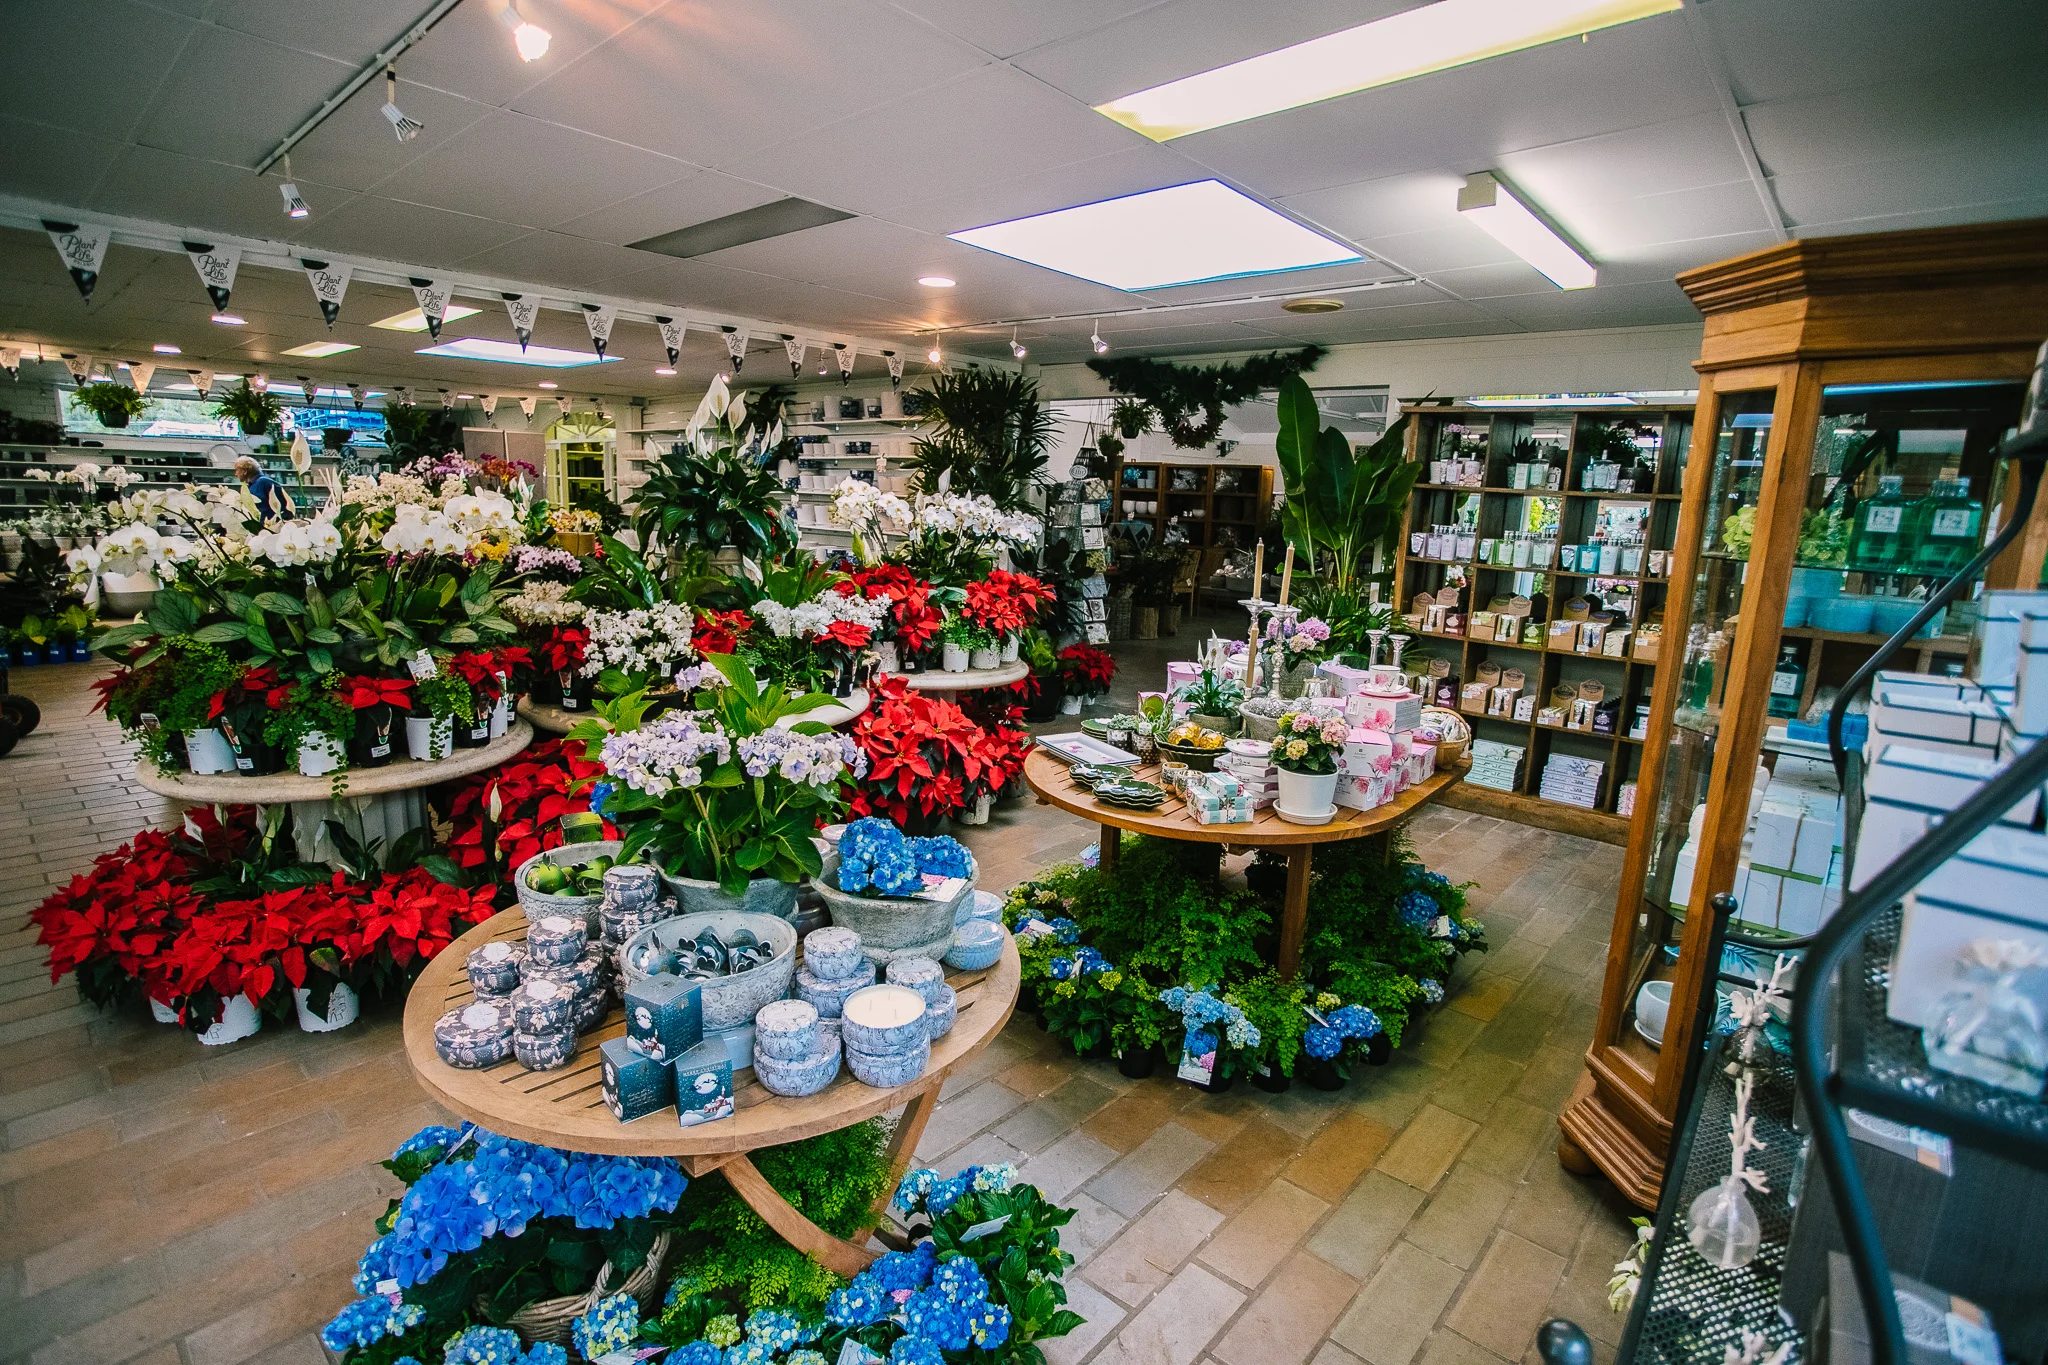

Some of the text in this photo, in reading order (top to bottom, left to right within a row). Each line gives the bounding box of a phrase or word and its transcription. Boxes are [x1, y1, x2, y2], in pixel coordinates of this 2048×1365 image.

[59, 235, 97, 251] Plant
[66, 246, 94, 262] Life
[197, 255, 230, 269] Plant
[203, 266, 227, 280] Life
[314, 271, 342, 285] Plant
[318, 281, 338, 295] Life
[420, 288, 444, 301] Plant
[423, 299, 441, 311] Life
[514, 311, 530, 322] Life
